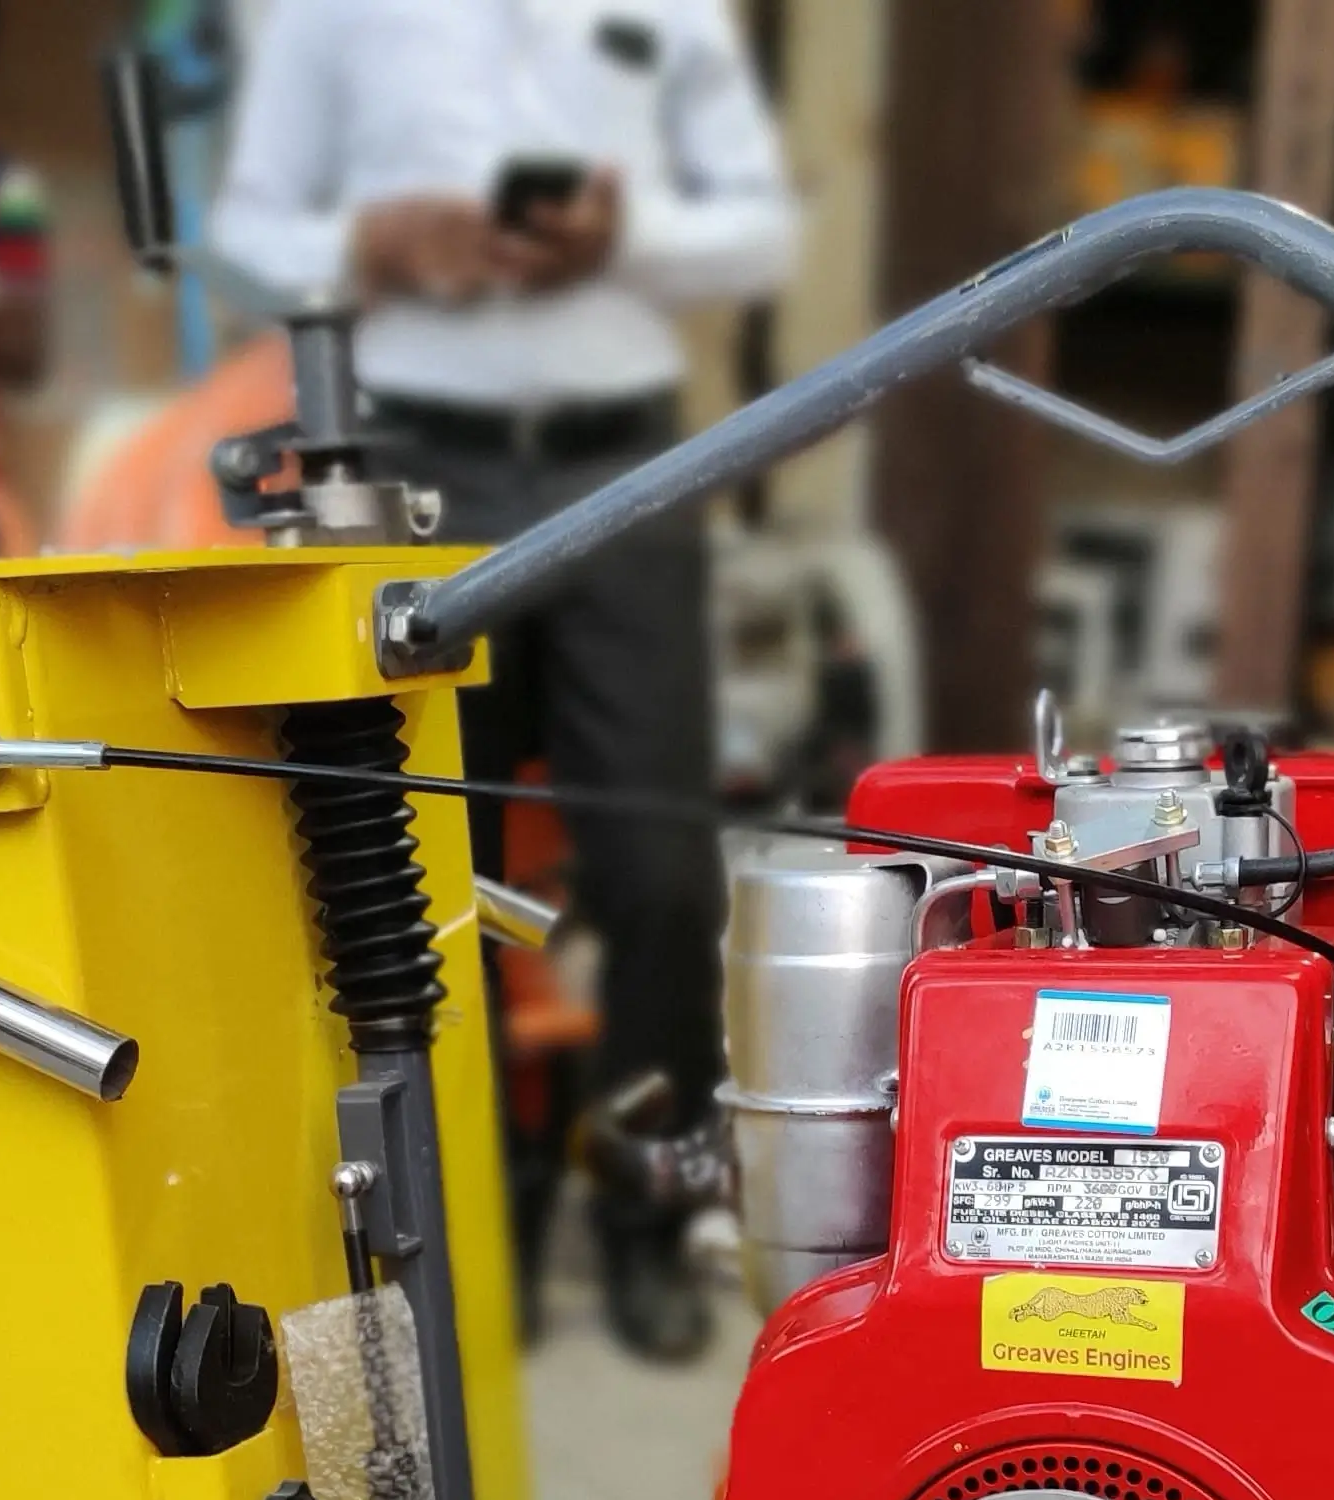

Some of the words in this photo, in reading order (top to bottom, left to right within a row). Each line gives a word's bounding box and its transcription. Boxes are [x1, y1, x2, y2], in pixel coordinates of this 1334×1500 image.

[983, 1148, 1053, 1162] GREAVES
[1055, 1149, 1109, 1164] MODEL
[982, 1165, 1002, 1179] Sr.
[1011, 1165, 1034, 1179] No.
[983, 1195, 1012, 1207] 299
[1041, 1229, 1085, 1239] GREAVES
[1087, 1230, 1126, 1240] COTTON
[1128, 1231, 1166, 1241] LIMITED
[993, 1342, 1079, 1365] Greaves
[1086, 1347, 1171, 1371] Engines
